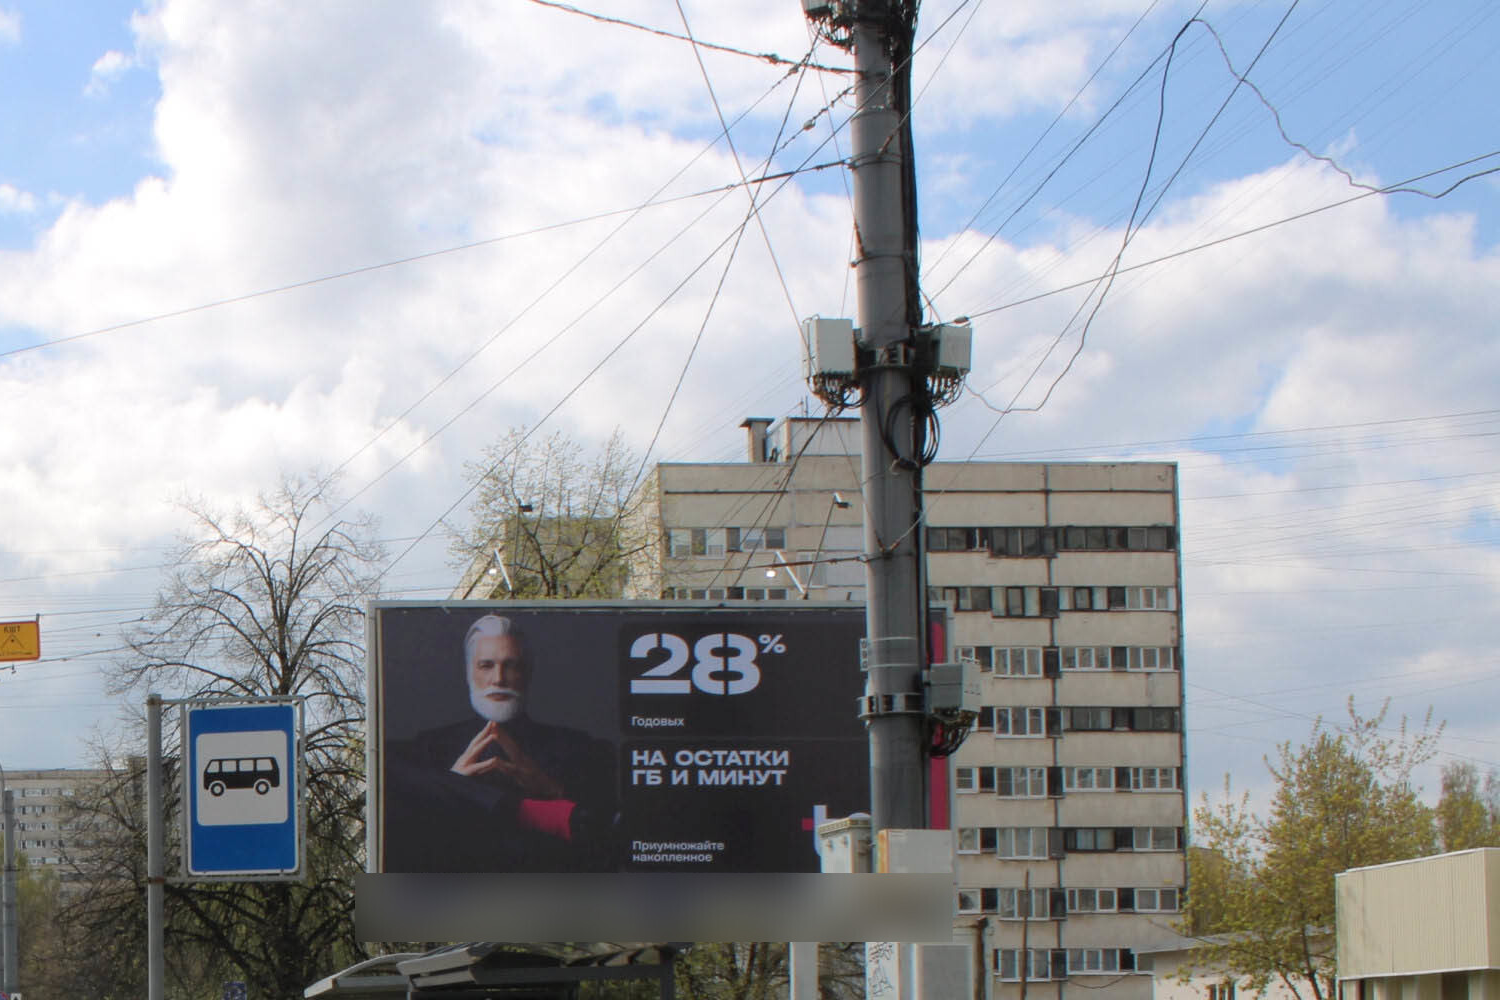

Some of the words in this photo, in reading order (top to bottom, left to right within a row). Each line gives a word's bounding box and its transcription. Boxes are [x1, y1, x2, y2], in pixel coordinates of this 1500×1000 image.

[630, 633, 787, 695] 28%
[631, 716, 685, 728] Годовых
[632, 750, 667, 766] НА
[675, 750, 789, 766] ОСТАТКИ
[632, 769, 663, 785] ГБ
[671, 769, 689, 785] И
[698, 769, 787, 785] МИНУТ
[632, 840, 725, 852] Приумножайте
[632, 853, 713, 862] накопленное
